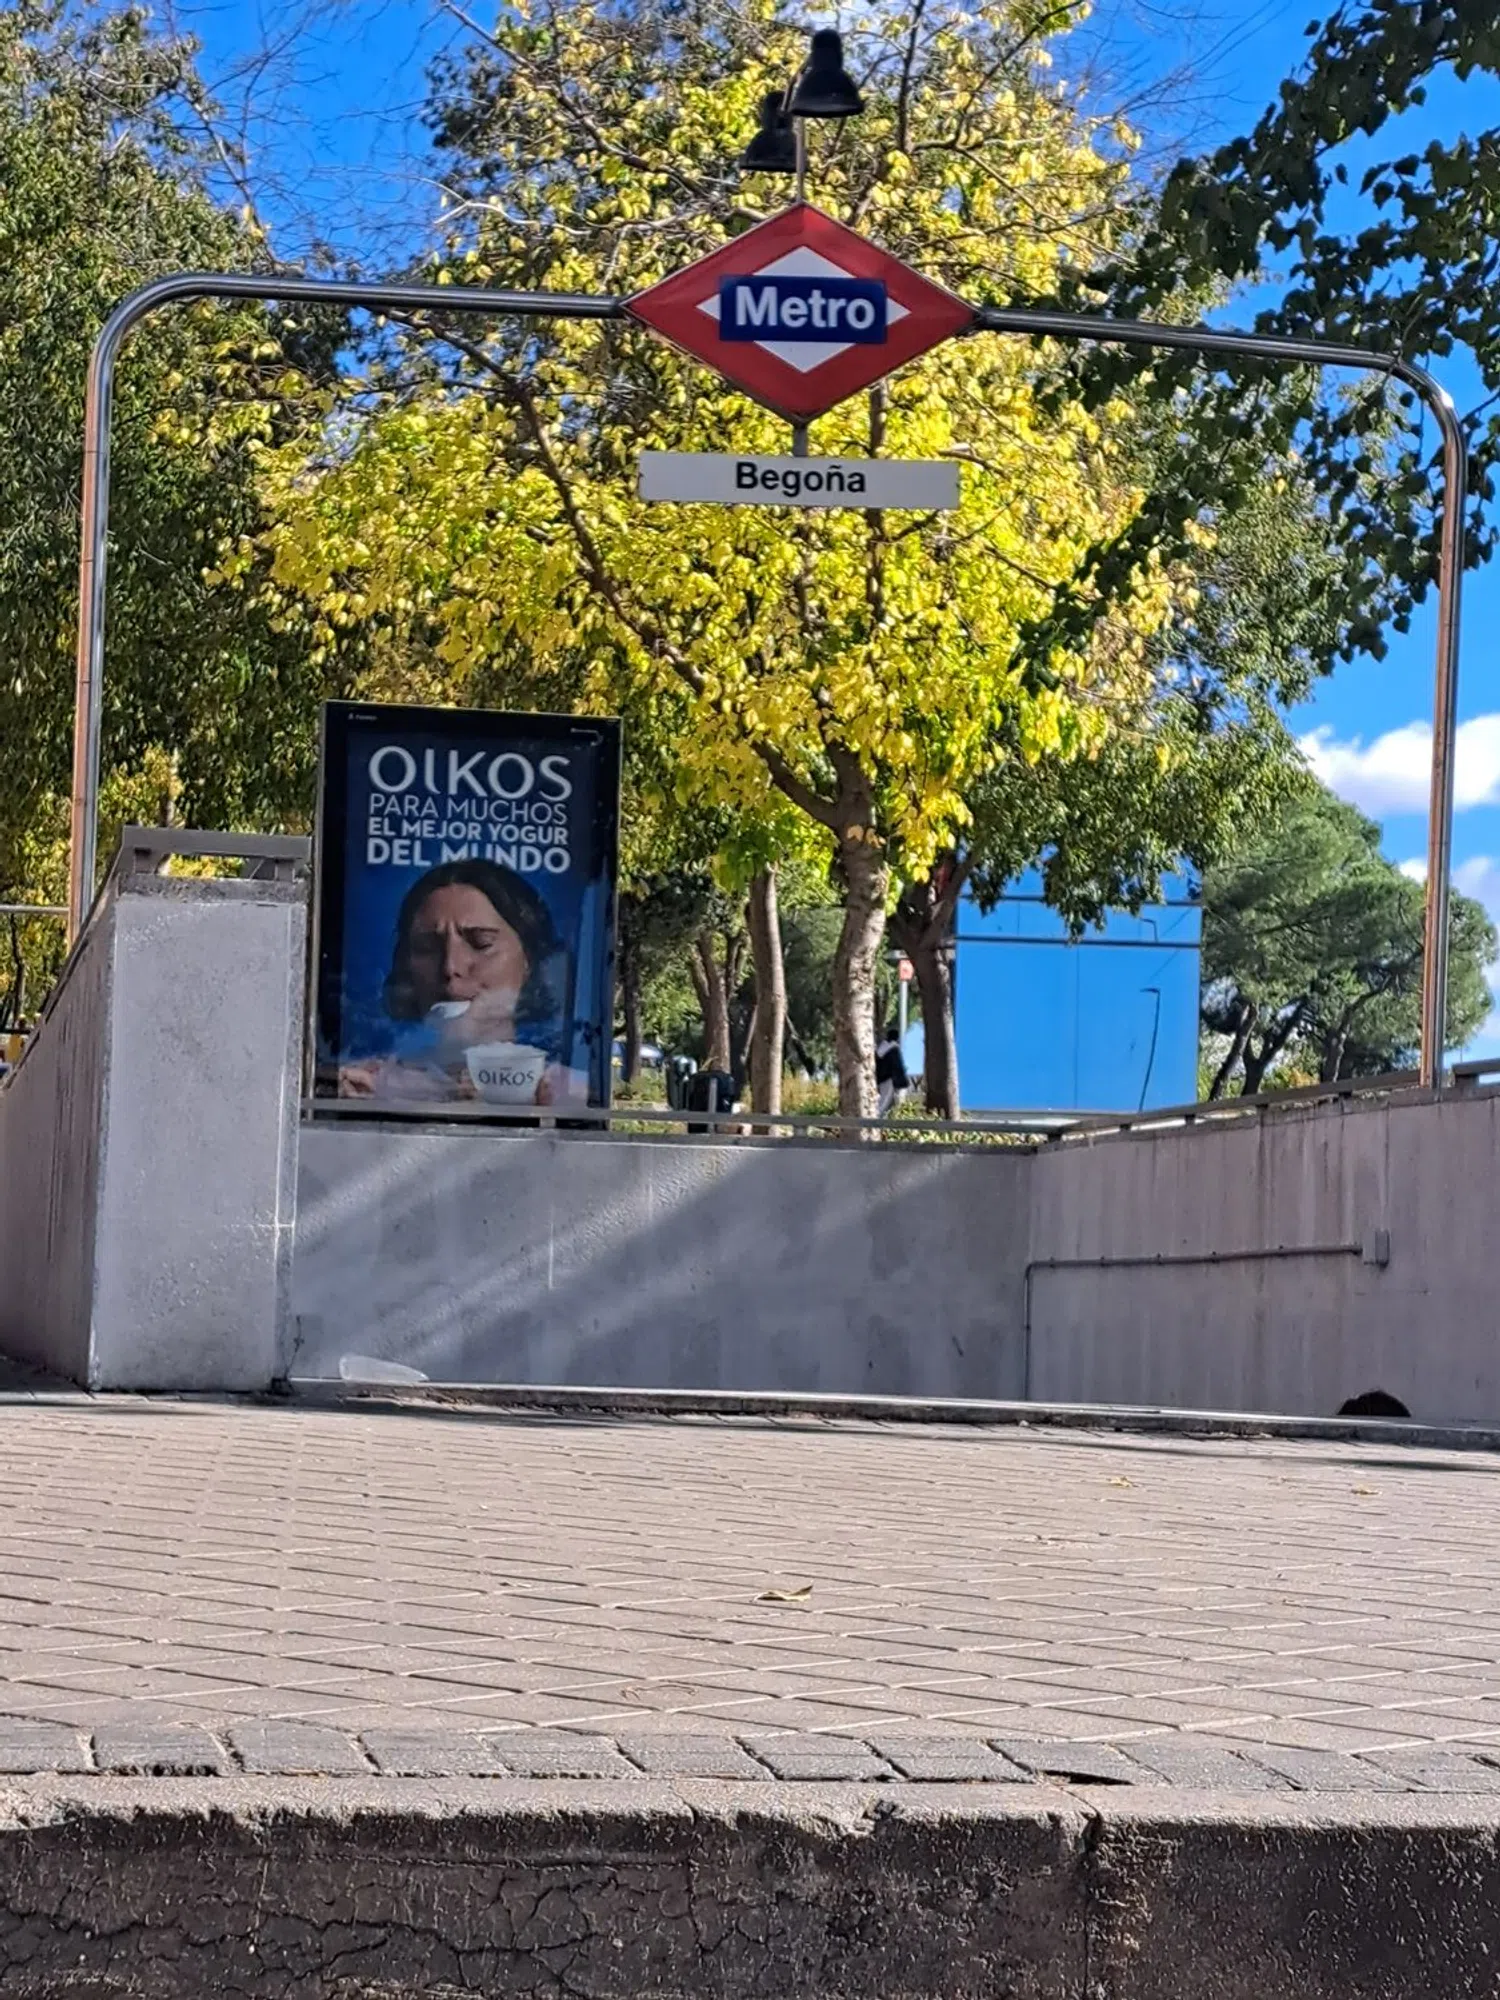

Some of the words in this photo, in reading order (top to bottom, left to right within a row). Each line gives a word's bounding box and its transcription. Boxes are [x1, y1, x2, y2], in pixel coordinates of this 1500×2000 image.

[735, 286, 876, 329] Metro
[736, 461, 866, 497] Begoña
[369, 746, 572, 801] OIKOS
[369, 794, 439, 817] PARA
[448, 799, 567, 824] MUCHOS
[368, 817, 395, 836] EL
[402, 820, 481, 840] MEJOR
[489, 823, 568, 845] YOGUR
[367, 838, 431, 866] DEL
[478, 1069, 534, 1086] OIKOS
